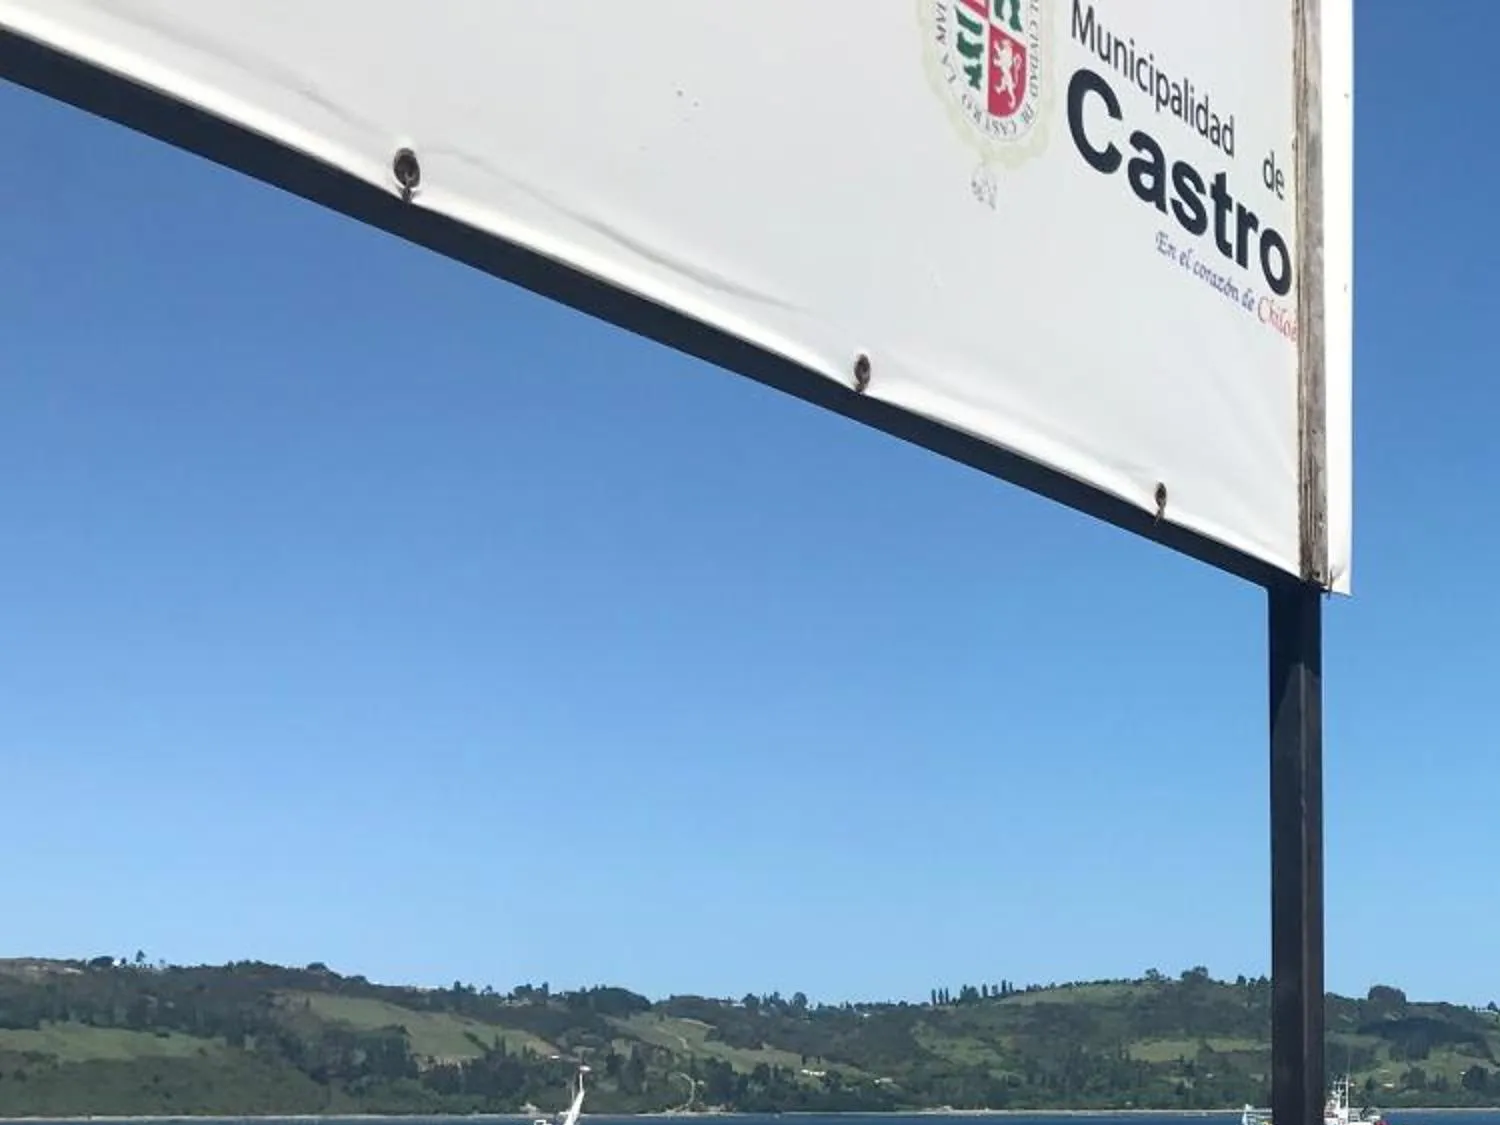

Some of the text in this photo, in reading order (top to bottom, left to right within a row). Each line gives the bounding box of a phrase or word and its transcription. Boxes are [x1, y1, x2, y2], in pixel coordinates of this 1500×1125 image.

[1067, 68, 1292, 297] Castro
[1071, 0, 1235, 157] Municipalidad
[1262, 150, 1285, 201] de
[1156, 231, 1177, 260] En
[1180, 248, 1193, 270] el
